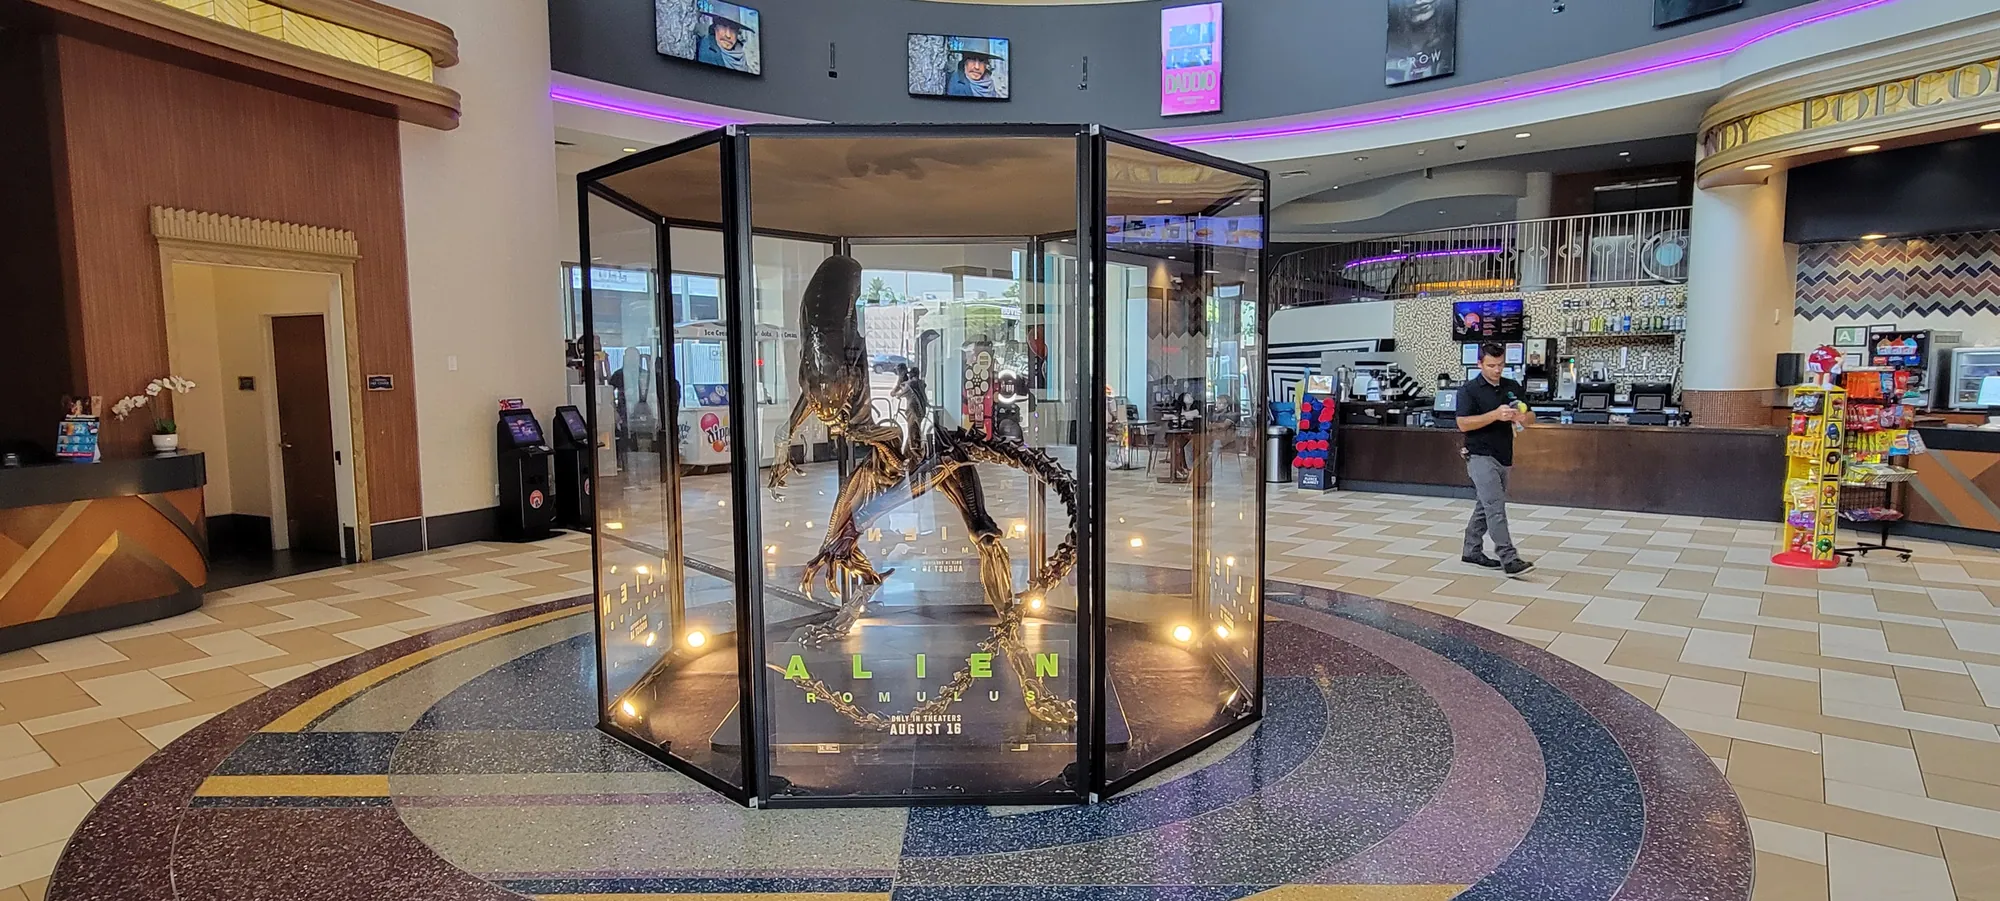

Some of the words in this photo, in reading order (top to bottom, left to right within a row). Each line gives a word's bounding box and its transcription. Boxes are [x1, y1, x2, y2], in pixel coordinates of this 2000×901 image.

[1165, 70, 1216, 95] DADDIO
[1803, 59, 2000, 130] POPCO
[1838, 330, 1852, 342] A
[783, 653, 1059, 680] ALIEN
[806, 690, 1036, 703] ROMULUS
[891, 714, 910, 722] ONLY
[912, 714, 921, 722] IN
[923, 714, 962, 722] THEATERS
[889, 722, 941, 735] AUGUST
[946, 722, 962, 735] 16
